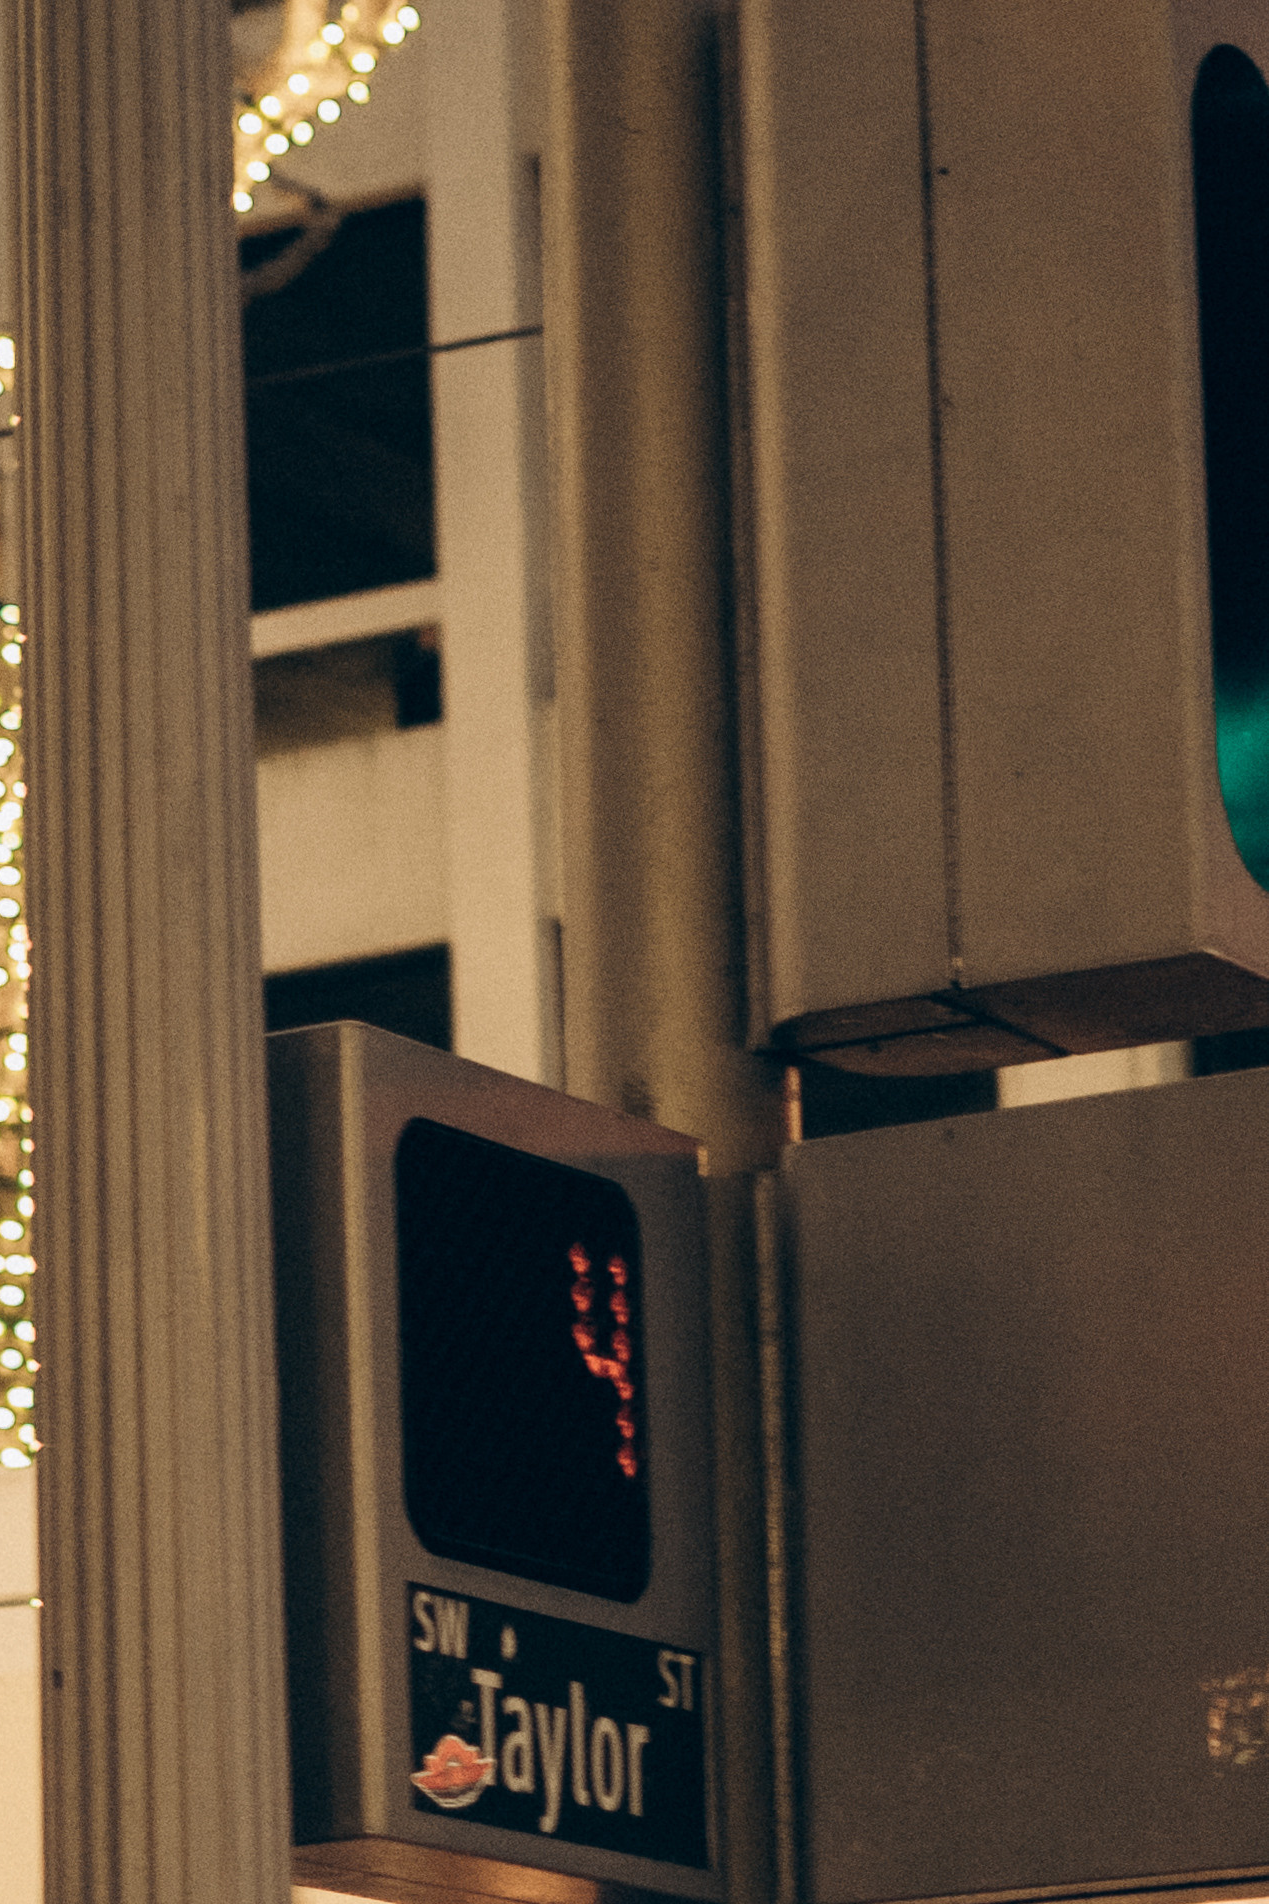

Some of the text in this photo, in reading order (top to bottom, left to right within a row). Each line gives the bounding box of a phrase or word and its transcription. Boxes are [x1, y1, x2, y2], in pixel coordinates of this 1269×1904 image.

[412, 1590, 696, 1833] SW Taylor ST
